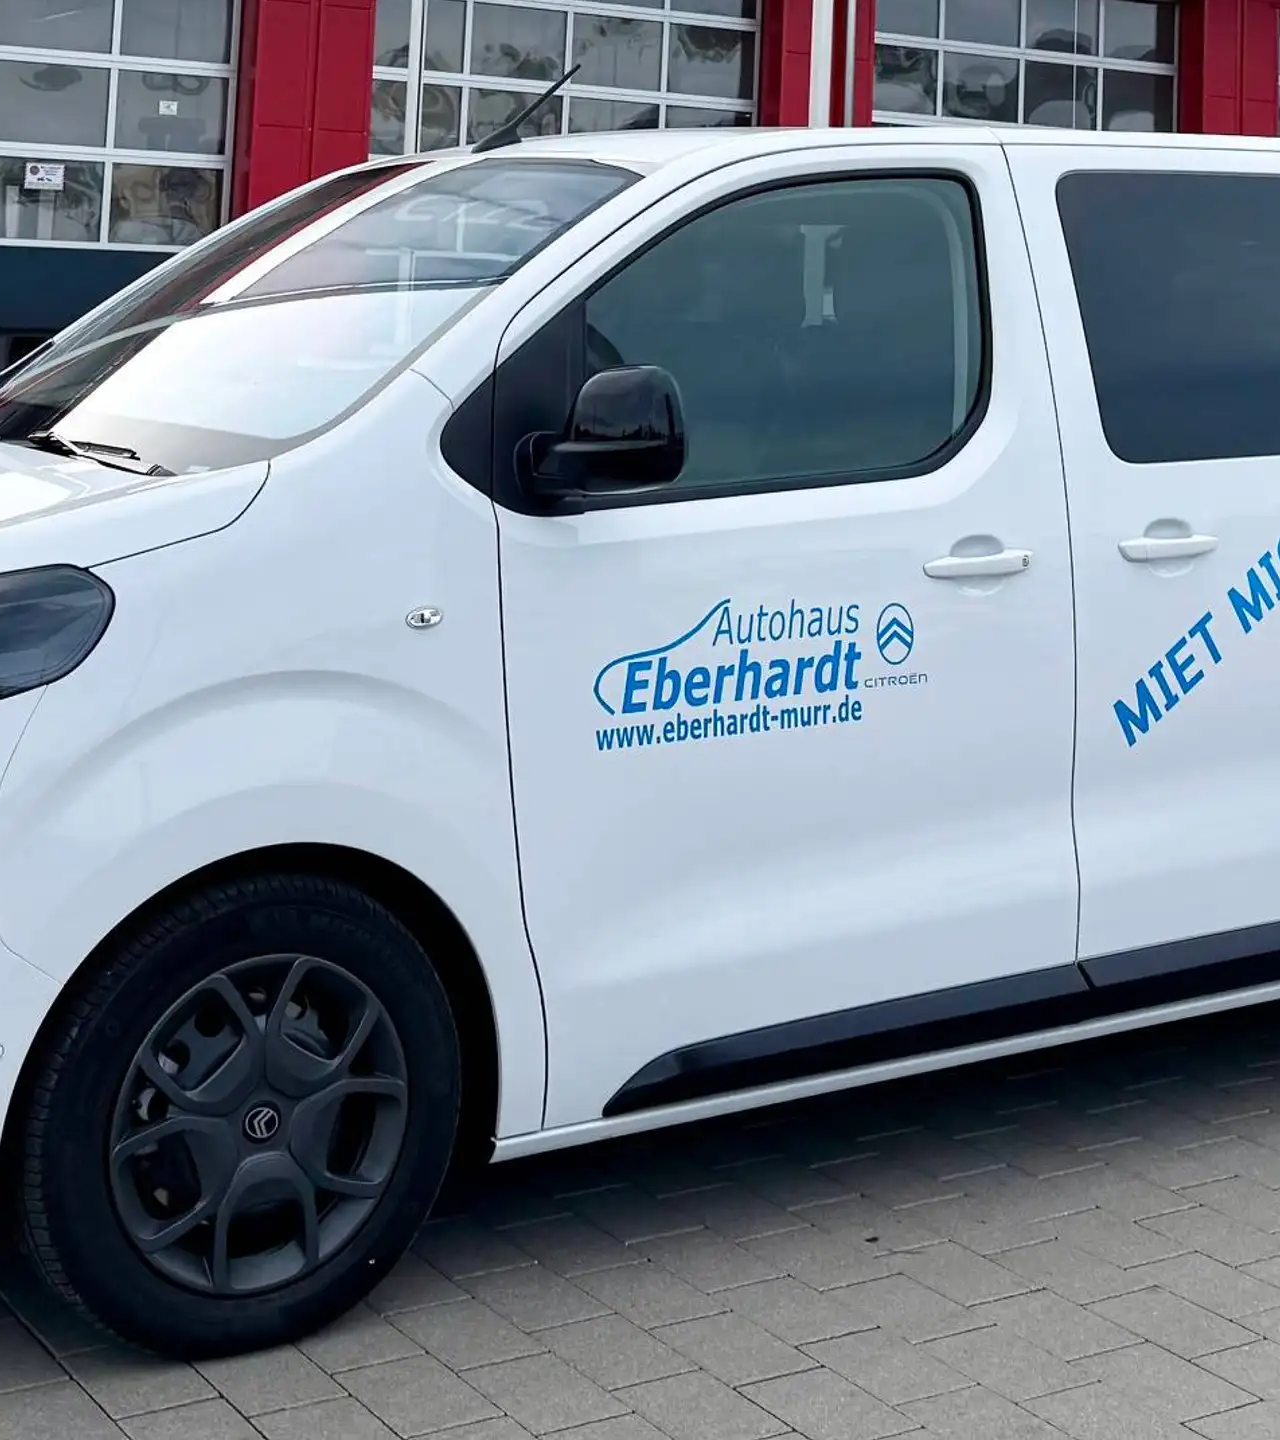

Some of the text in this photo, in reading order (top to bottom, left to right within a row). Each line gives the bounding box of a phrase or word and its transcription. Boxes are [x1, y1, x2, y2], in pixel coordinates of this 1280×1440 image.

[712, 598, 860, 646] Autohaus
[621, 640, 862, 714] Eberhardt
[1113, 612, 1222, 747] MIET
[595, 694, 863, 751] www.eberhardt-murr.de
